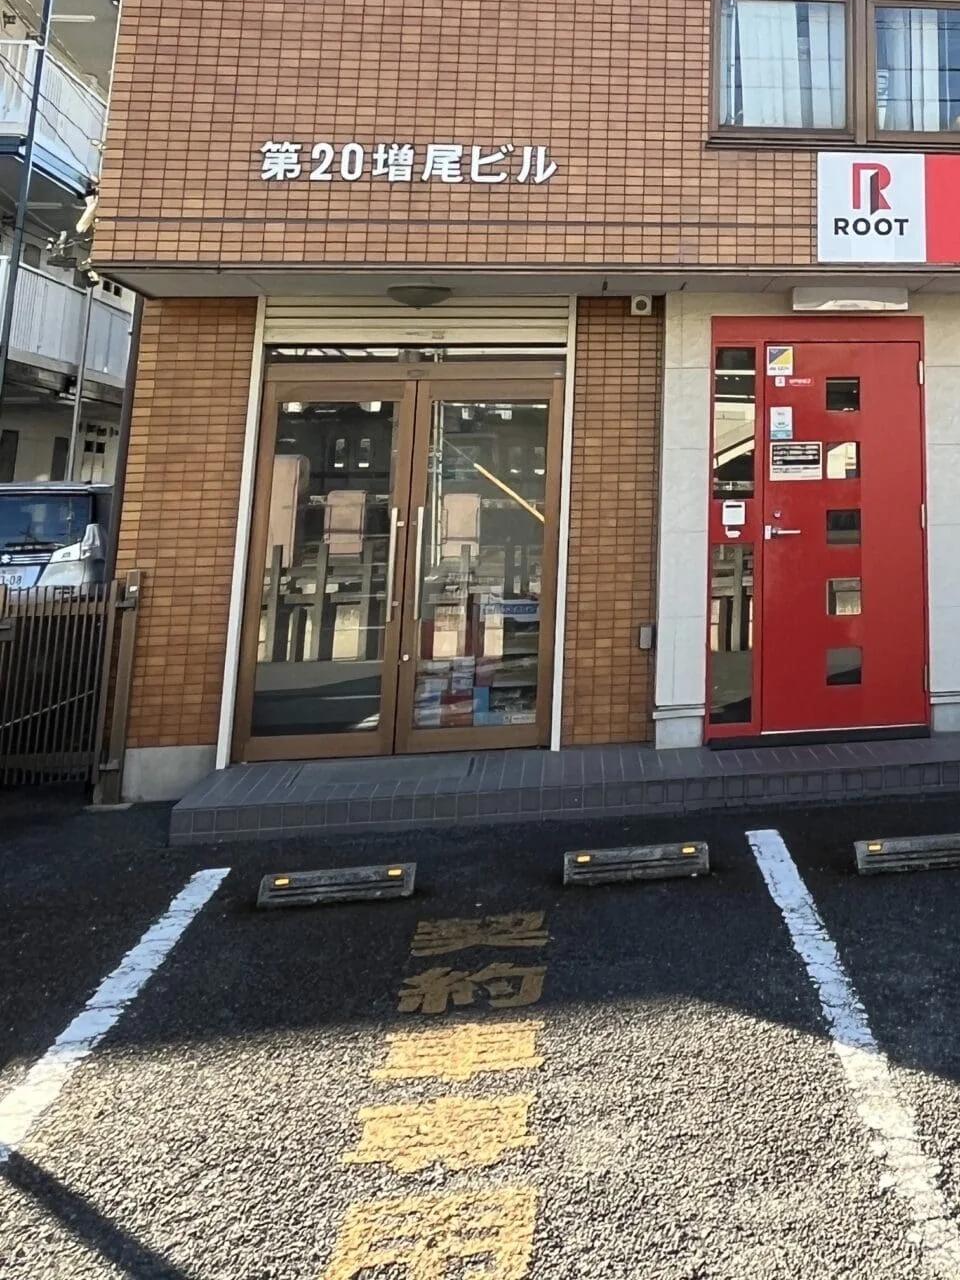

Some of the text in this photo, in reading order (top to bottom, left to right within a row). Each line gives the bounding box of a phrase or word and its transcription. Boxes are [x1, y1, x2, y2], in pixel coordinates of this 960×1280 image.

[260, 141, 558, 184] 第20増尾ビル
[833, 217, 909, 236] ROOT
